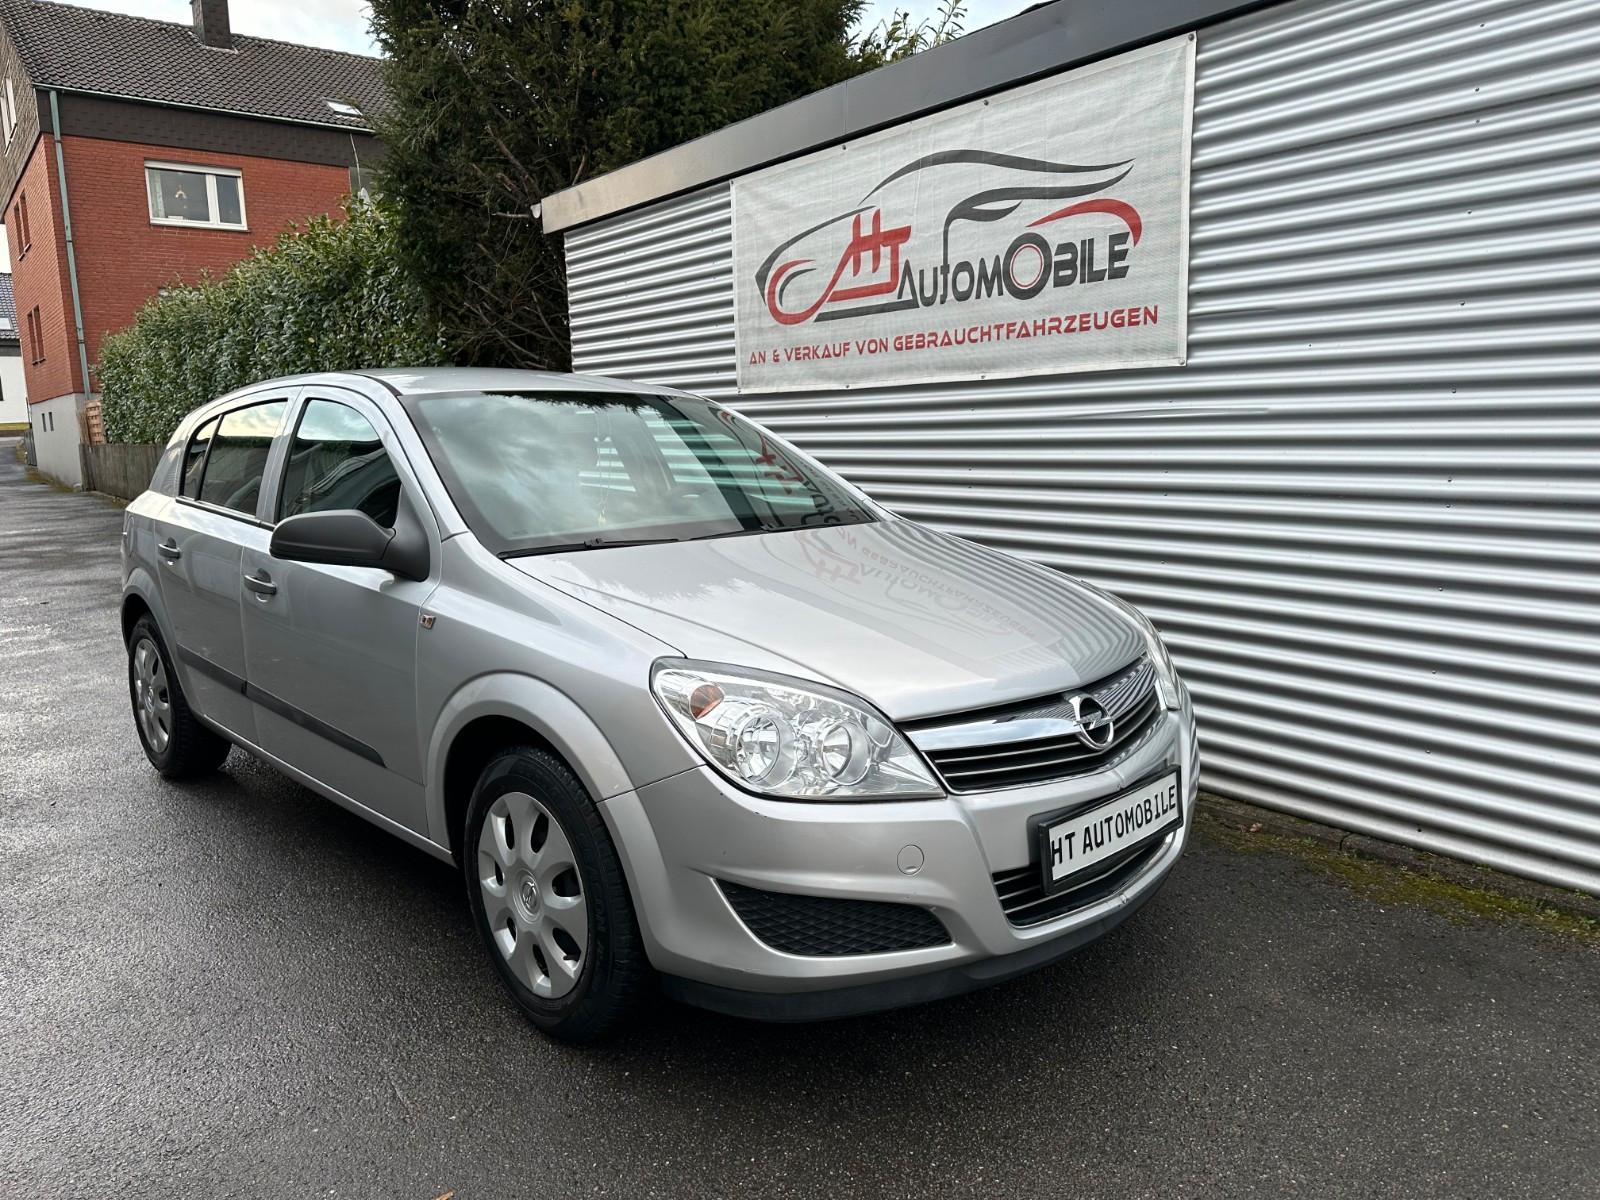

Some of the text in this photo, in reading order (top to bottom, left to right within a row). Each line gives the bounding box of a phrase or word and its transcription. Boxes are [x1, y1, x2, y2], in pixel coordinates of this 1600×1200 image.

[749, 305, 1158, 365] AN & VERKAUF VON GEBRAUCHTFAHRZEUGEN
[1051, 785, 1176, 867] HT AUTOMOBILE
